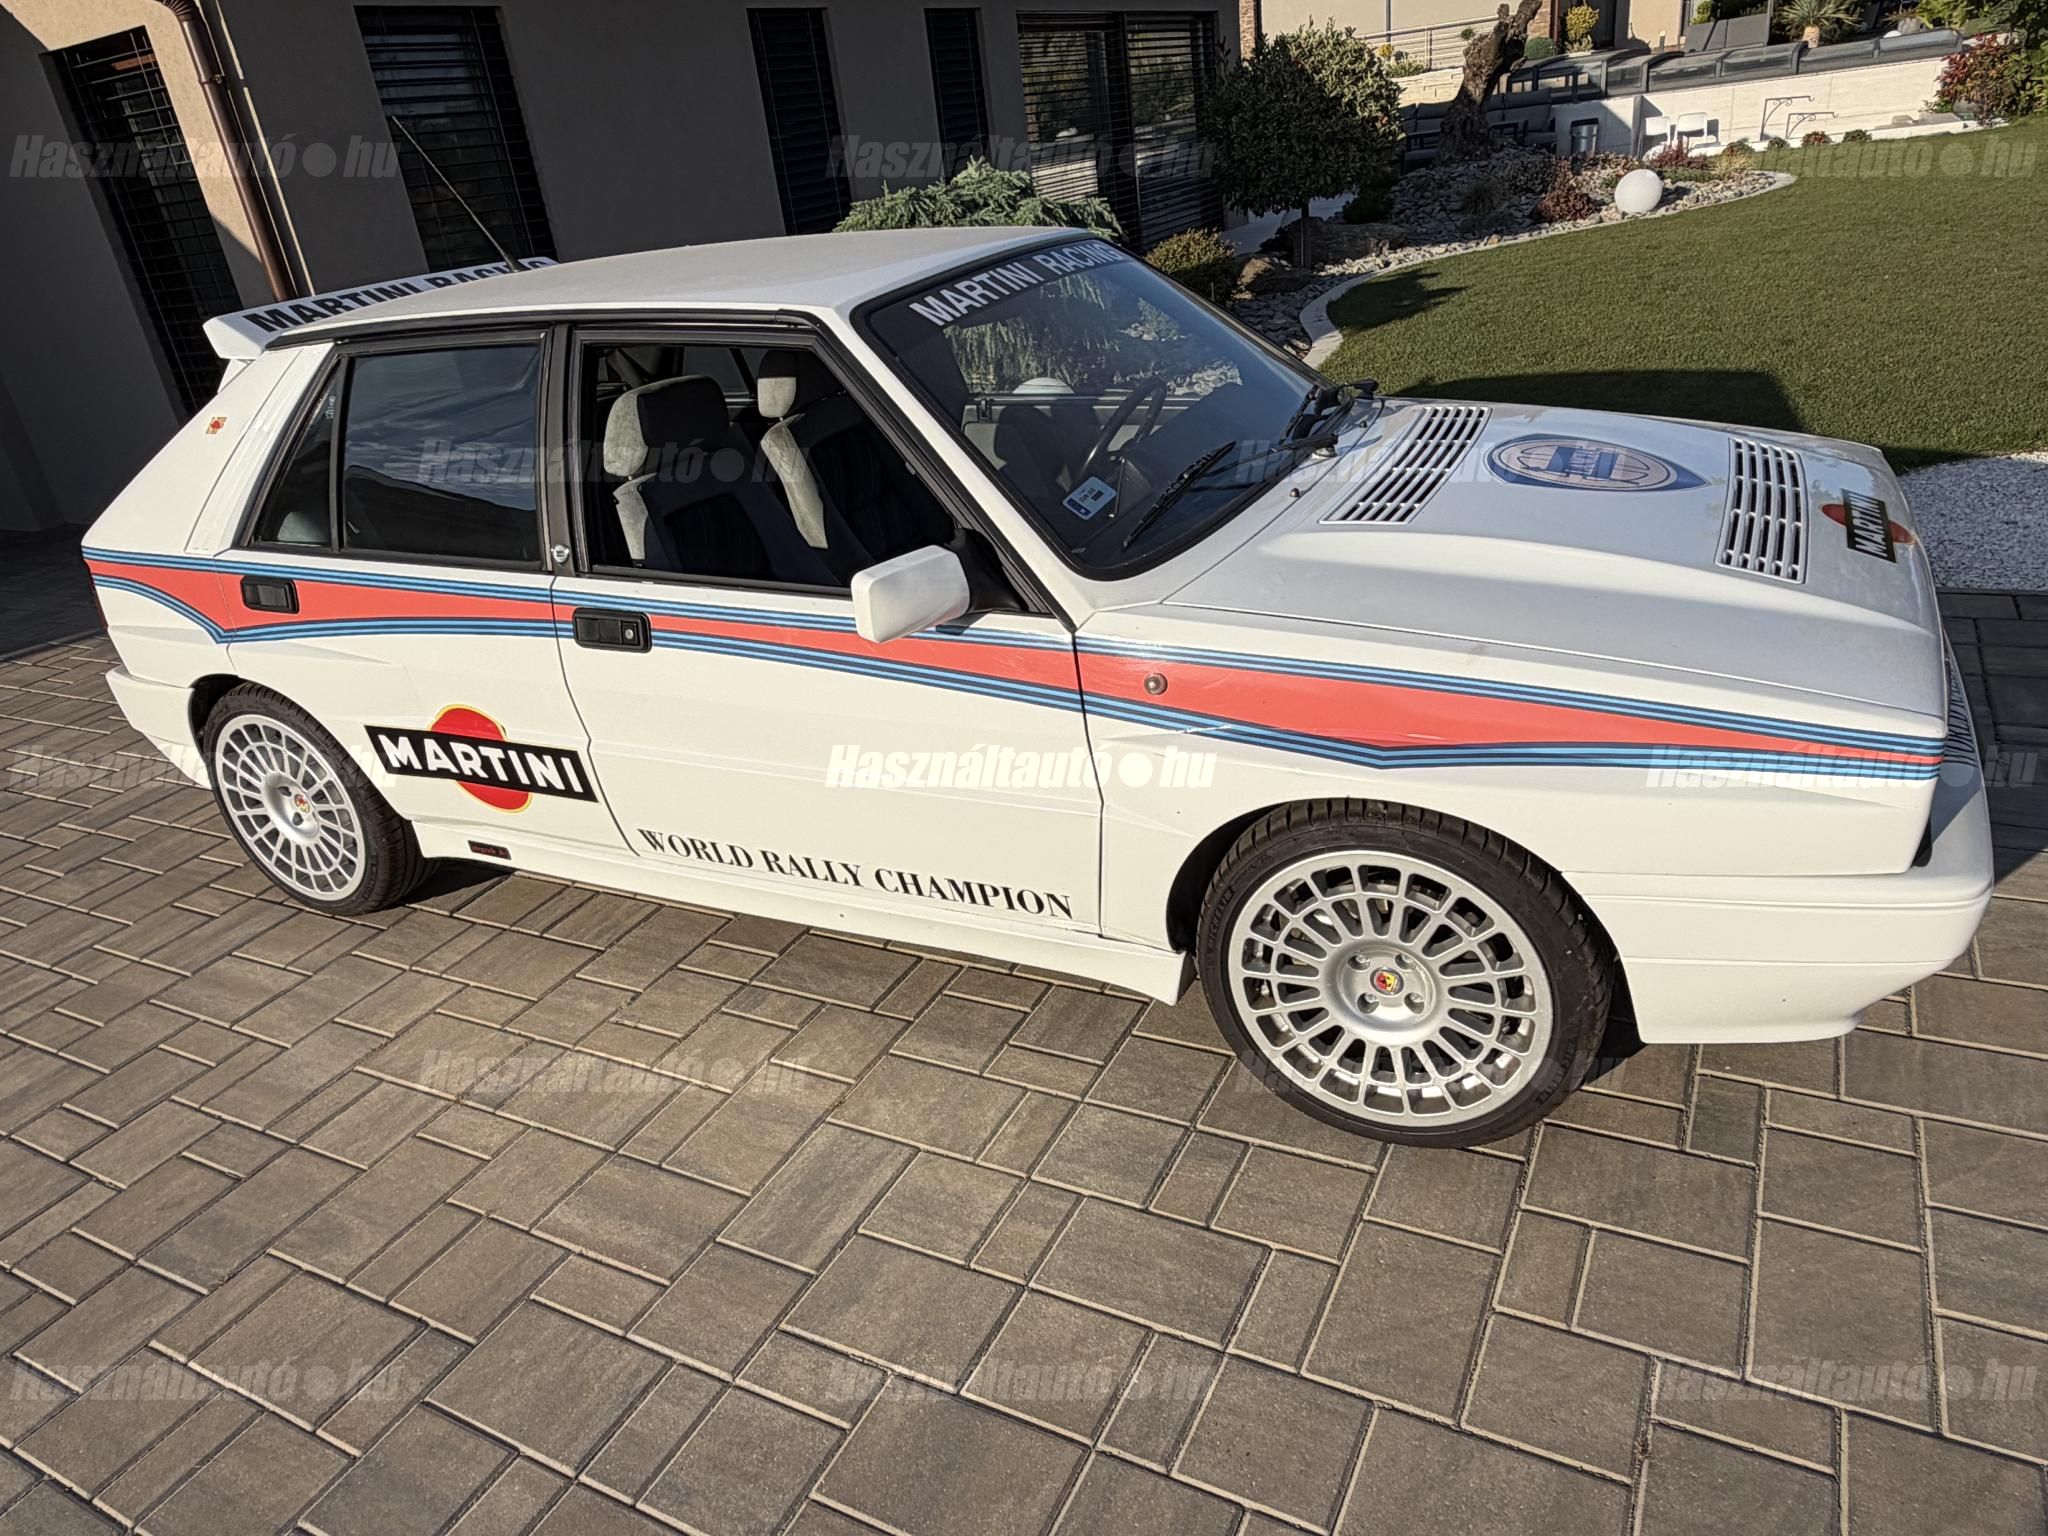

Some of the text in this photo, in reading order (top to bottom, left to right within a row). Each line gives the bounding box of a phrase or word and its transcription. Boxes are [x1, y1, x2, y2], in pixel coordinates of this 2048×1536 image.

[243, 282, 423, 333] MARTINI
[909, 242, 1125, 326] MARTINI RACING
[1848, 492, 1888, 557] MARTINI
[377, 734, 584, 793] MARTINI
[637, 828, 1073, 919] WORLD RALLY CHAMPION
